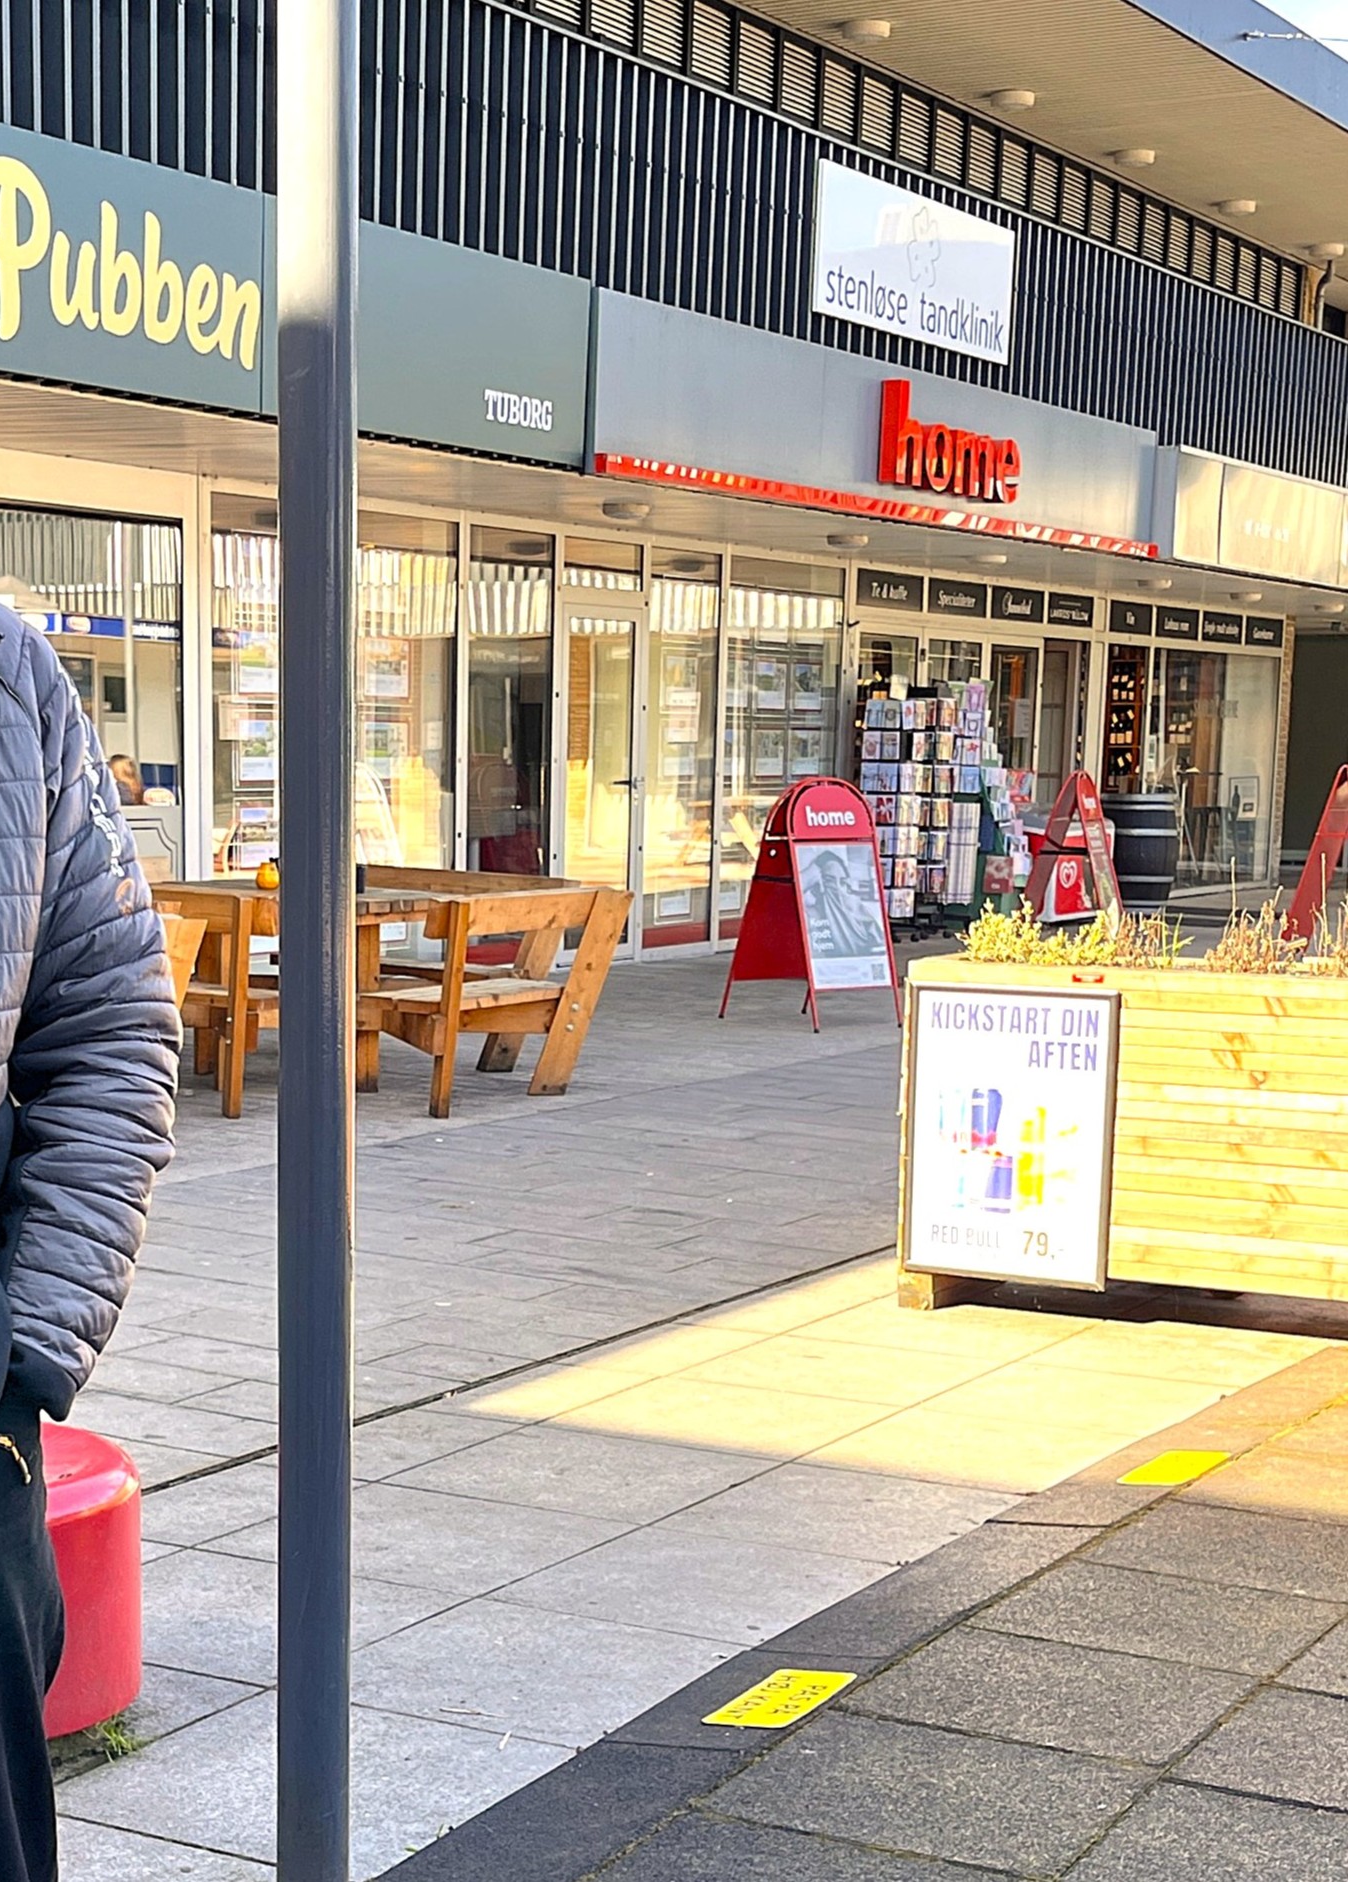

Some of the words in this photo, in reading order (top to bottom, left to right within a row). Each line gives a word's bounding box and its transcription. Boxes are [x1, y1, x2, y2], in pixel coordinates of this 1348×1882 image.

[825, 265, 908, 325] stenløse
[920, 292, 1004, 353] tandklinik
[484, 388, 553, 432] TUBORG
[878, 379, 1022, 504] home
[805, 805, 856, 827] home
[931, 1001, 1051, 1035] KICKSTART
[1061, 1008, 1100, 1038] DIN
[1028, 1040, 1097, 1071] AFTEN
[931, 1224, 958, 1245] RED
